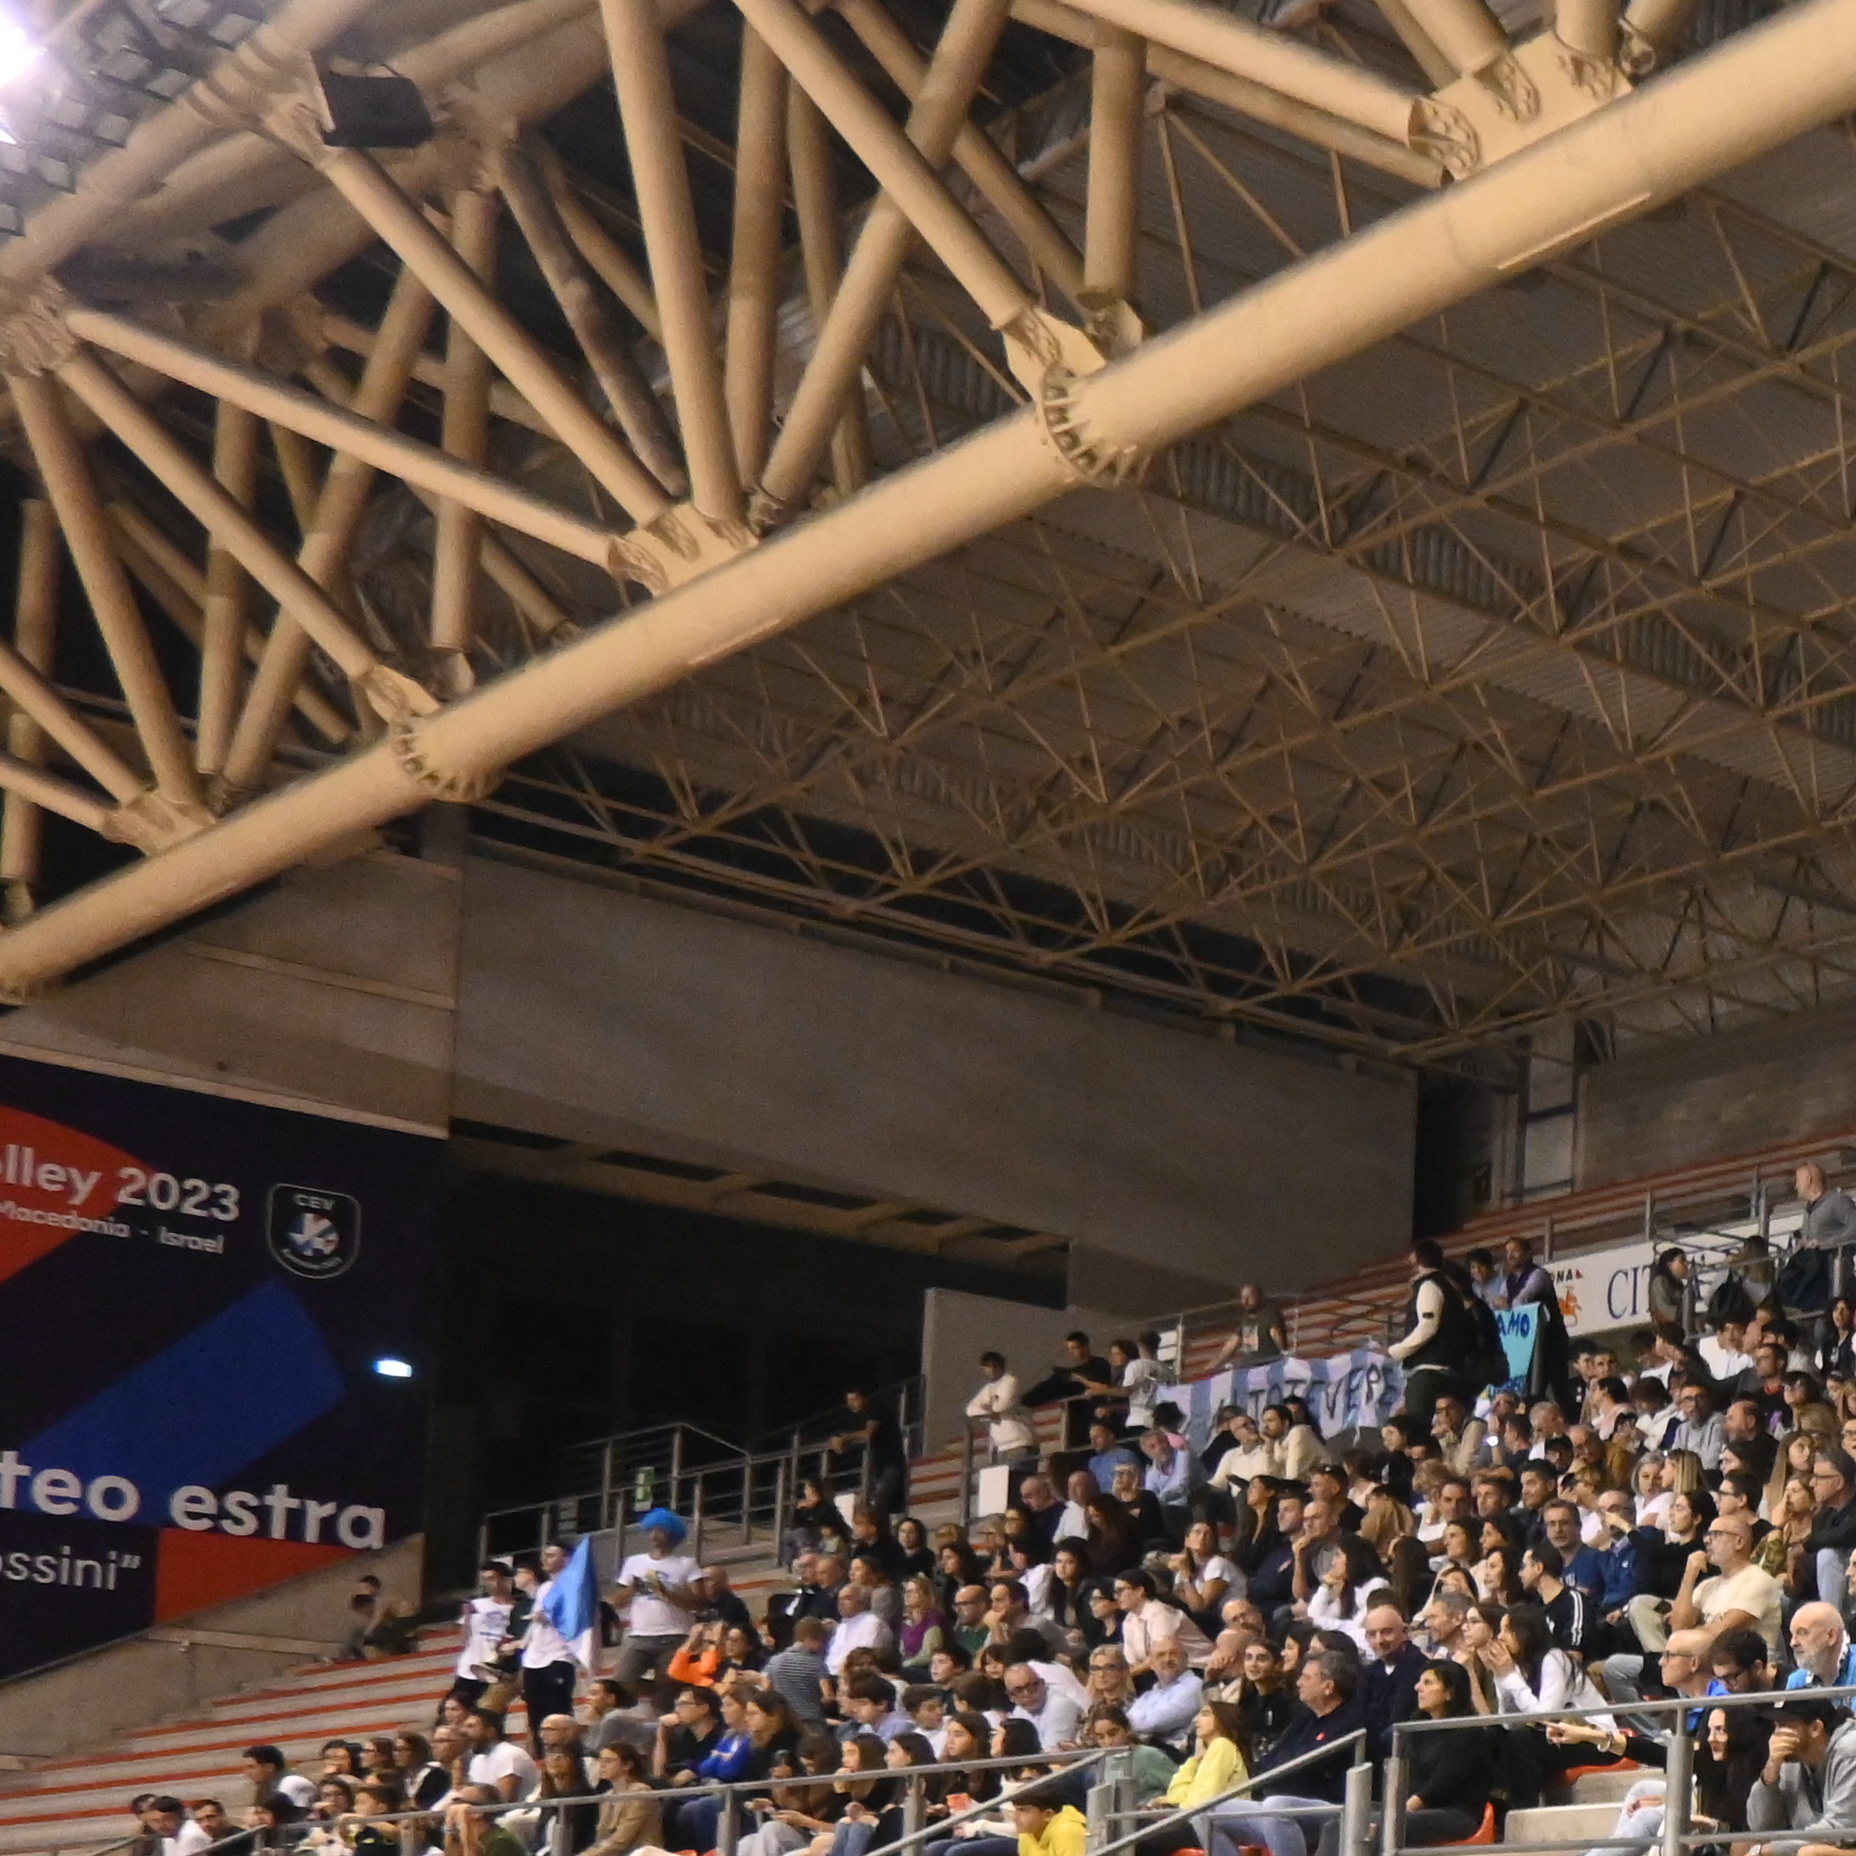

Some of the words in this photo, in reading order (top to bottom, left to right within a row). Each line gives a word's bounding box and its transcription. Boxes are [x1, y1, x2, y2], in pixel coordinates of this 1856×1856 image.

[0, 1144, 102, 1206] lley
[118, 1167, 241, 1222] 2023
[158, 1226, 225, 1254] Israel
[0, 1451, 140, 1522] teo
[170, 1483, 385, 1549] estra
